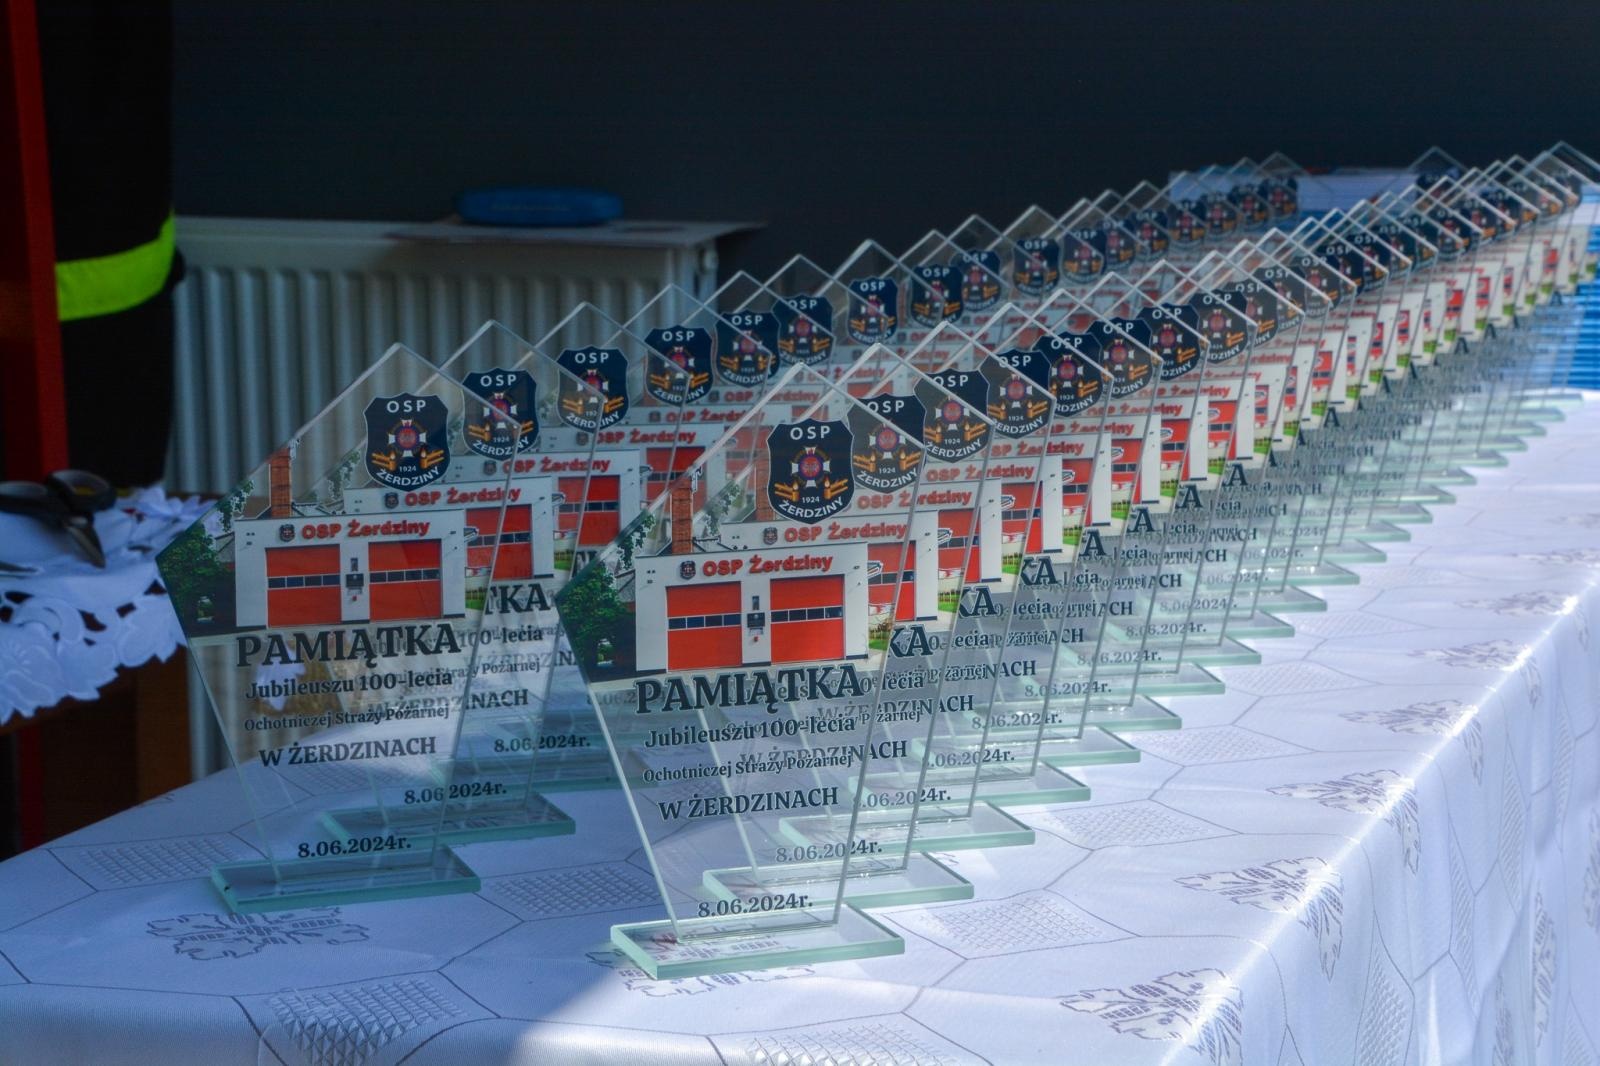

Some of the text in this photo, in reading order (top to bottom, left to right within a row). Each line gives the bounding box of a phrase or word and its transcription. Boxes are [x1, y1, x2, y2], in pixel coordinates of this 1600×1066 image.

[1024, 240, 1048, 250] OSP
[922, 268, 950, 278] OSP
[860, 281, 886, 292] OSP
[1235, 283, 1263, 293] OSP
[788, 299, 818, 310] OSP
[1203, 293, 1232, 305] OSP
[731, 315, 764, 326] OSP
[1152, 308, 1182, 319] OSP
[662, 330, 695, 341] OSP
[1103, 322, 1134, 334] OSP
[1050, 337, 1083, 350] OSP
[574, 353, 609, 364] OSP
[998, 355, 1032, 368] OSP
[480, 374, 518, 387] OSP
[932, 374, 969, 388] OSP
[653, 386, 705, 402] ŻERDINY
[386, 400, 426, 414] OSP
[868, 399, 906, 414] OSP
[565, 411, 620, 429] ŻERDINY
[992, 416, 1045, 434] ŻERDZINY
[630, 427, 697, 444] Żerdzny
[790, 426, 832, 441] OSP
[472, 436, 530, 456] ŻERDZNY
[926, 438, 982, 458] ŻERDZINY
[399, 465, 418, 473] 1924
[540, 455, 611, 473] Żerdzny
[375, 465, 441, 488] ŻERDZINY
[856, 467, 918, 489] ŻERDZINY
[926, 467, 961, 482] OSP
[404, 490, 441, 507] OSP
[801, 495, 820, 504] 1924
[857, 494, 894, 510] OSP
[778, 496, 844, 519] ŻERDZINY
[302, 518, 431, 539] OSP Żerdziny
[784, 520, 907, 543] OSP Żerdziny
[702, 554, 834, 577] OSP Żerdziny
[235, 622, 463, 669] PAMIĄTKA
[1077, 650, 1162, 666] 8.6.2024r.
[245, 667, 454, 700] Jubileuszu 100-lecia
[635, 663, 864, 714] PAMIĄTKA
[244, 701, 450, 732] Ochotniczej Straży Pożarnej
[861, 708, 921, 728] Pżarnej
[972, 712, 1063, 729] 8.6.2024r.
[645, 724, 755, 748] Jubileuszu
[760, 713, 856, 739] 100-lecia
[258, 736, 437, 767] W ŻERDZINACH
[926, 748, 1015, 769] .06.2024r.
[643, 752, 852, 783] Ochotniczej Straży Pożarnej
[404, 781, 508, 805] 8.062024r.
[858, 787, 952, 810] .06.2024r.
[658, 786, 839, 821] W ŻERDZINACH
[297, 835, 412, 859] 8.06.2024r.
[775, 838, 882, 863] 8.06.2024r.
[697, 892, 813, 918] 8.06.2024r.
